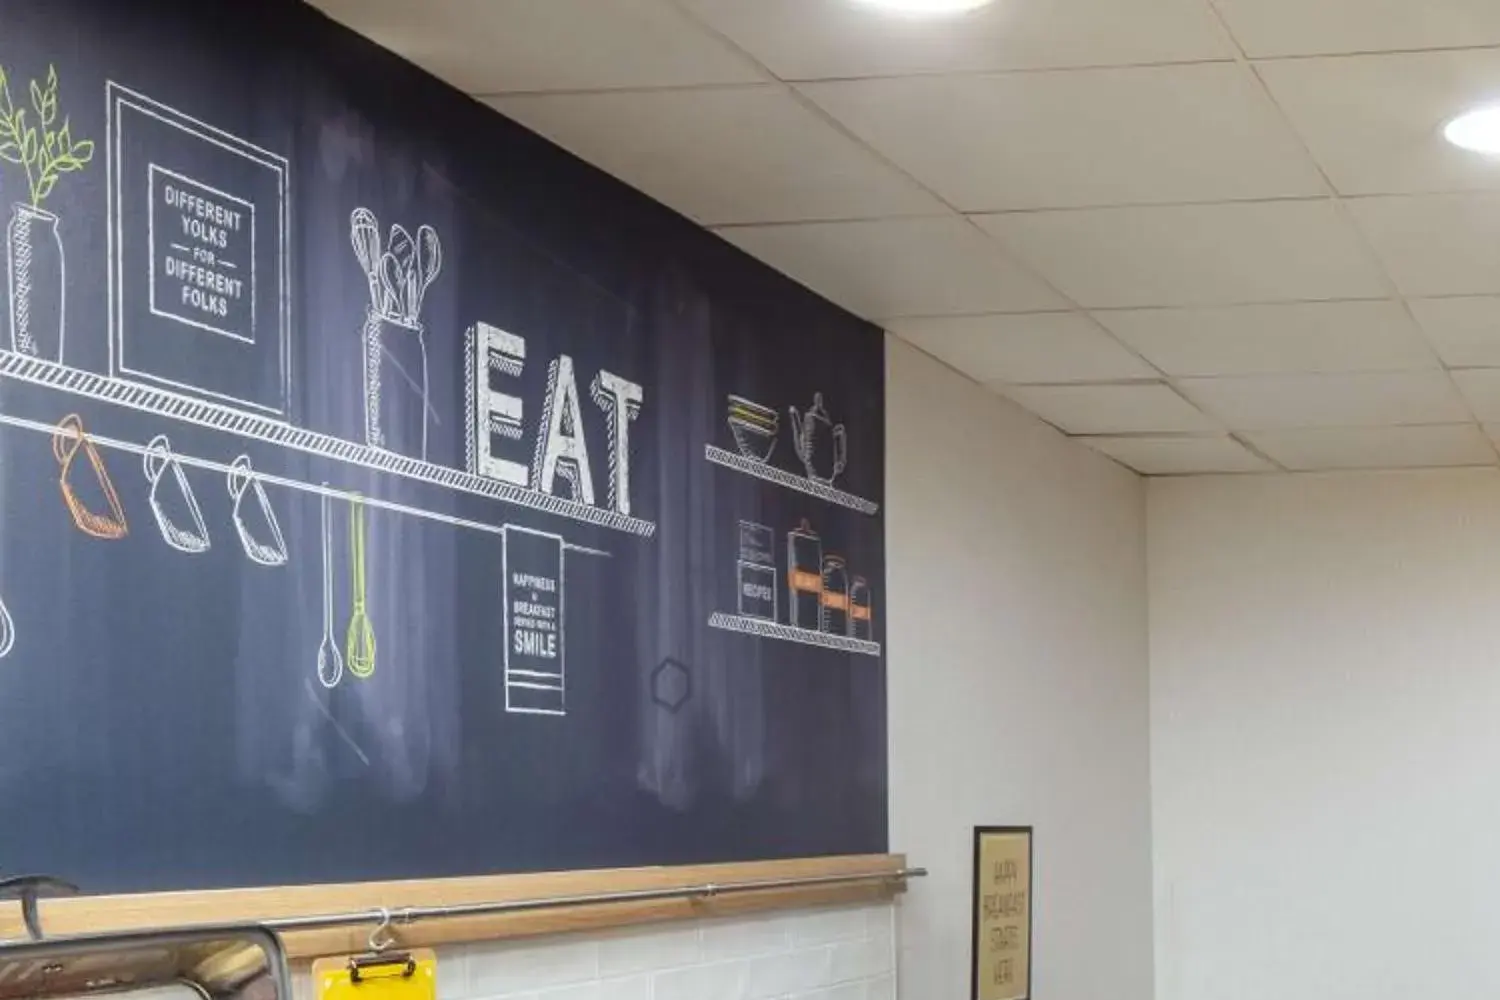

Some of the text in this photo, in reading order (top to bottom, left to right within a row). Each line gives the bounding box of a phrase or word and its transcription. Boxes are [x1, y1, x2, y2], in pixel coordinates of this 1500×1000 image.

[165, 185, 241, 231] DIFFERENT
[181, 214, 228, 248] YOLKS
[193, 247, 215, 265] FOR
[165, 256, 242, 299] DIFFERENT
[181, 286, 228, 317] FOLKS
[464, 321, 644, 515] EAT
[514, 629, 557, 658] SMILE
